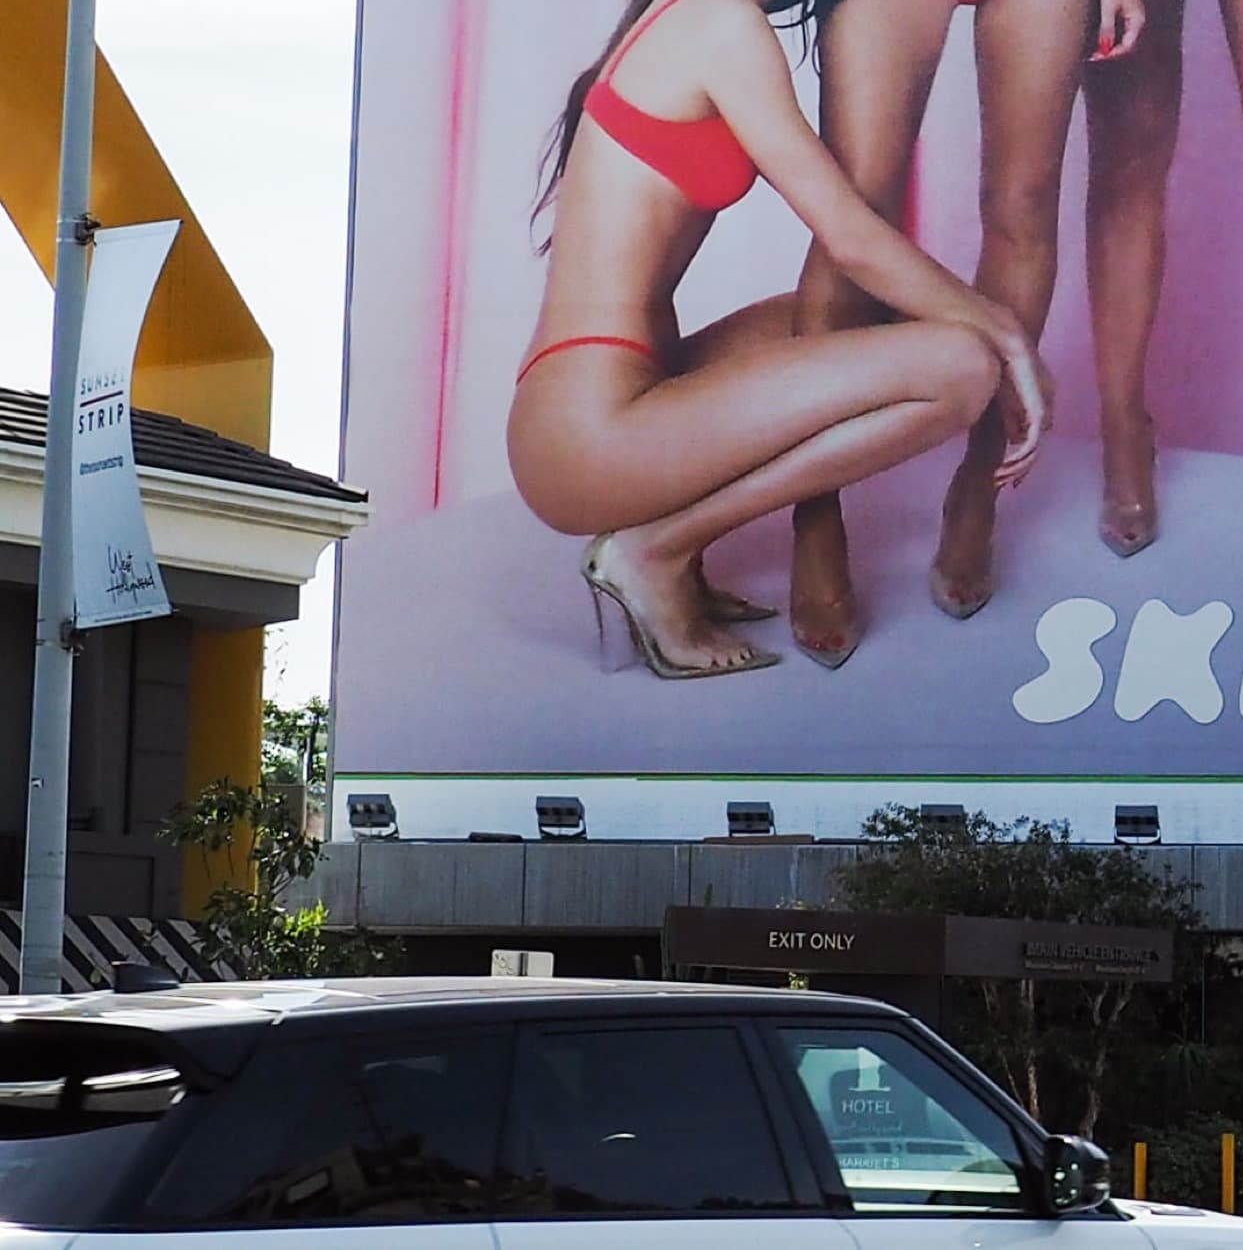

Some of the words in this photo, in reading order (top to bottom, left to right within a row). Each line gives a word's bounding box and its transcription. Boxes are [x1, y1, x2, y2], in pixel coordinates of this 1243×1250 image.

[78, 403, 124, 434] STRIP
[769, 931, 806, 949] EXIT
[810, 932, 855, 950] ONLY
[842, 1099, 896, 1114] HOTEL
